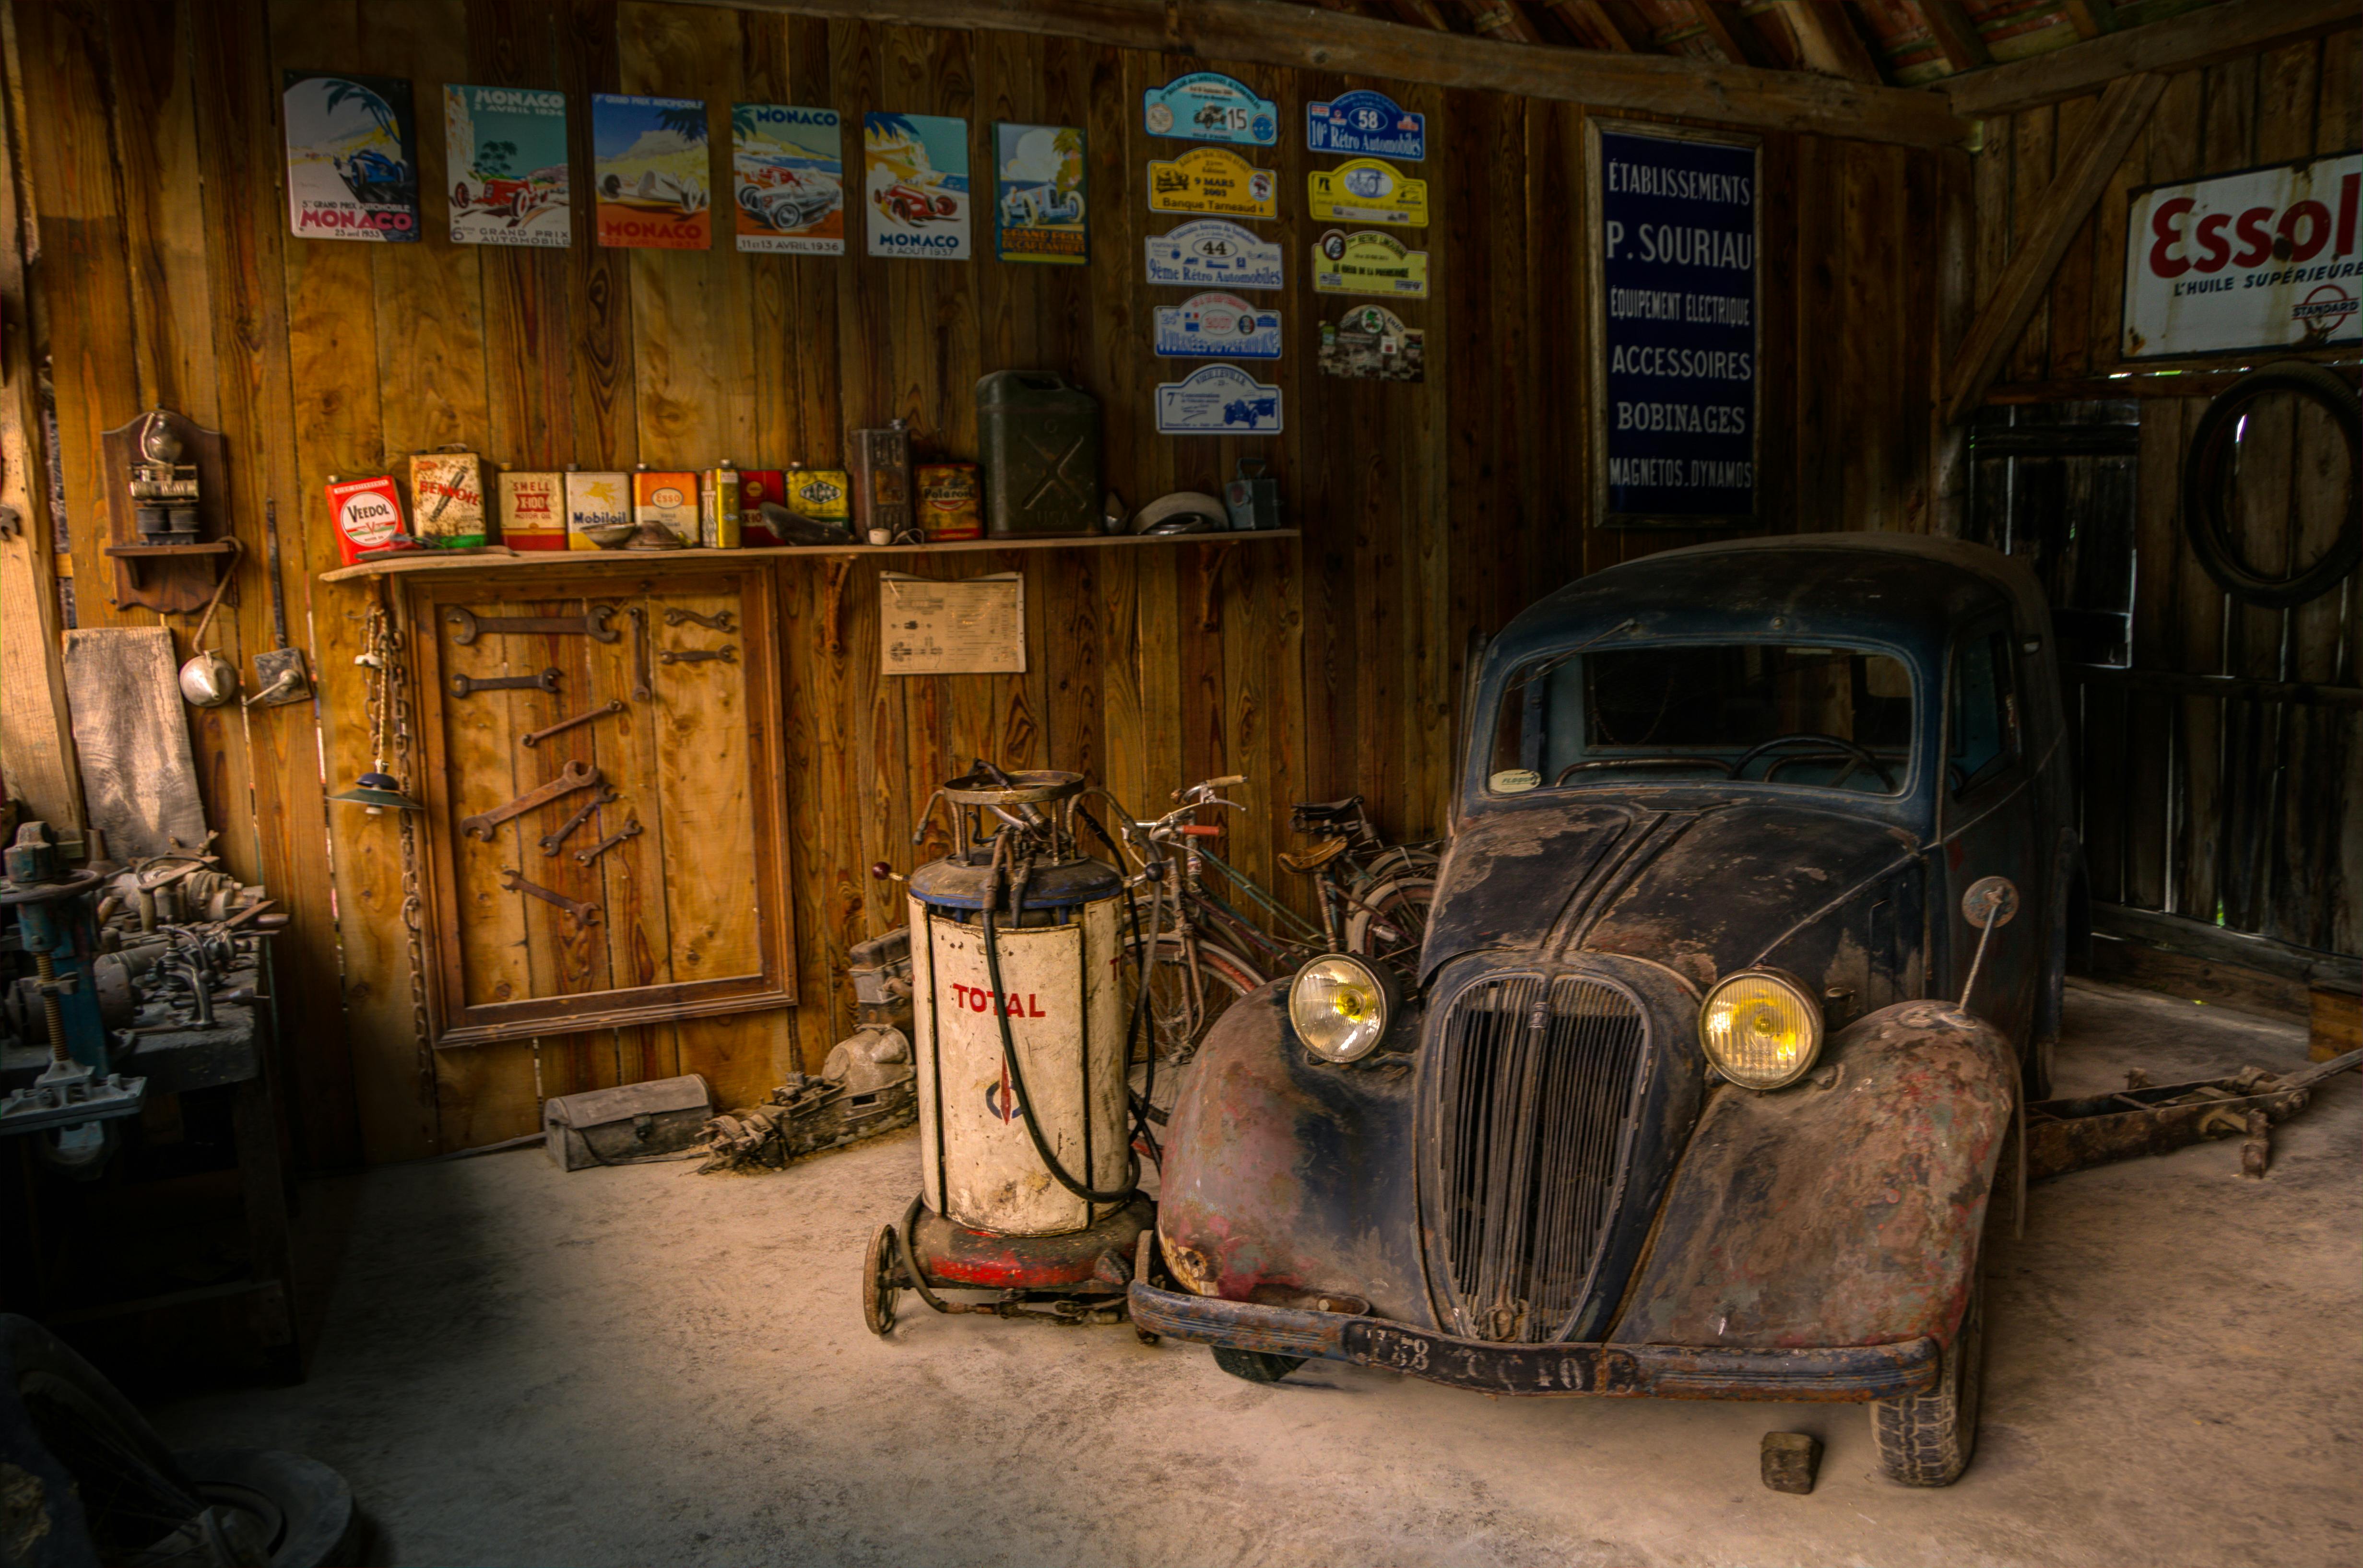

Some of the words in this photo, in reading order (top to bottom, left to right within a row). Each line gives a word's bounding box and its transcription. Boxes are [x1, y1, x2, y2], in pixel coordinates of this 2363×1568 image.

[474, 88, 566, 108] MONACO
[604, 95, 630, 105] GRAND
[631, 97, 650, 106] PRIX
[652, 98, 705, 110] AUTOMOBILE
[486, 105, 531, 115] AVRIL
[756, 109, 837, 126] MONACO
[1228, 108, 1247, 130] 15
[1358, 110, 1378, 129] 58
[1330, 125, 1360, 149] Rétro
[1361, 132, 1421, 156] Automobiles
[1194, 177, 1201, 185] 9
[1205, 177, 1235, 188] MARS
[1608, 157, 1751, 206] ÉTABLISSEMENTS
[314, 200, 337, 209] GRAND
[359, 203, 411, 212] AUTOMOBILE
[1162, 197, 1204, 210] Banque
[301, 209, 413, 231] MONACO
[480, 227, 527, 236] GRAND
[535, 230, 568, 238] PRIX
[605, 220, 702, 239] MONACO
[481, 236, 571, 246] AUTOMOBILE
[761, 240, 772, 249] 13
[775, 241, 811, 250] AVRIL
[812, 242, 839, 251] 1936
[880, 232, 959, 248] MONACO
[1203, 240, 1227, 255] 44
[929, 248, 954, 256] 1937
[1149, 258, 1179, 281] 9ème
[1182, 266, 1213, 282] Rétro
[1215, 267, 1282, 284] Automobiles
[2174, 276, 2235, 296] L'HUILE
[1610, 284, 1682, 322] ÉQUIPEMENT
[1685, 288, 1750, 329] ÉLECTRIQUE
[2293, 300, 2360, 318] STANDARD
[1611, 344, 1752, 382] ACCESSOIRES
[1617, 401, 1746, 436] BOBINAGES
[513, 482, 550, 491] SHELL
[802, 482, 838, 502] YACCO
[519, 496, 544, 509] X-100
[656, 493, 681, 503] Esso
[347, 504, 390, 523] VEEDOL
[573, 511, 626, 523] Mobiloil
[952, 983, 1046, 1018] TOTAL
